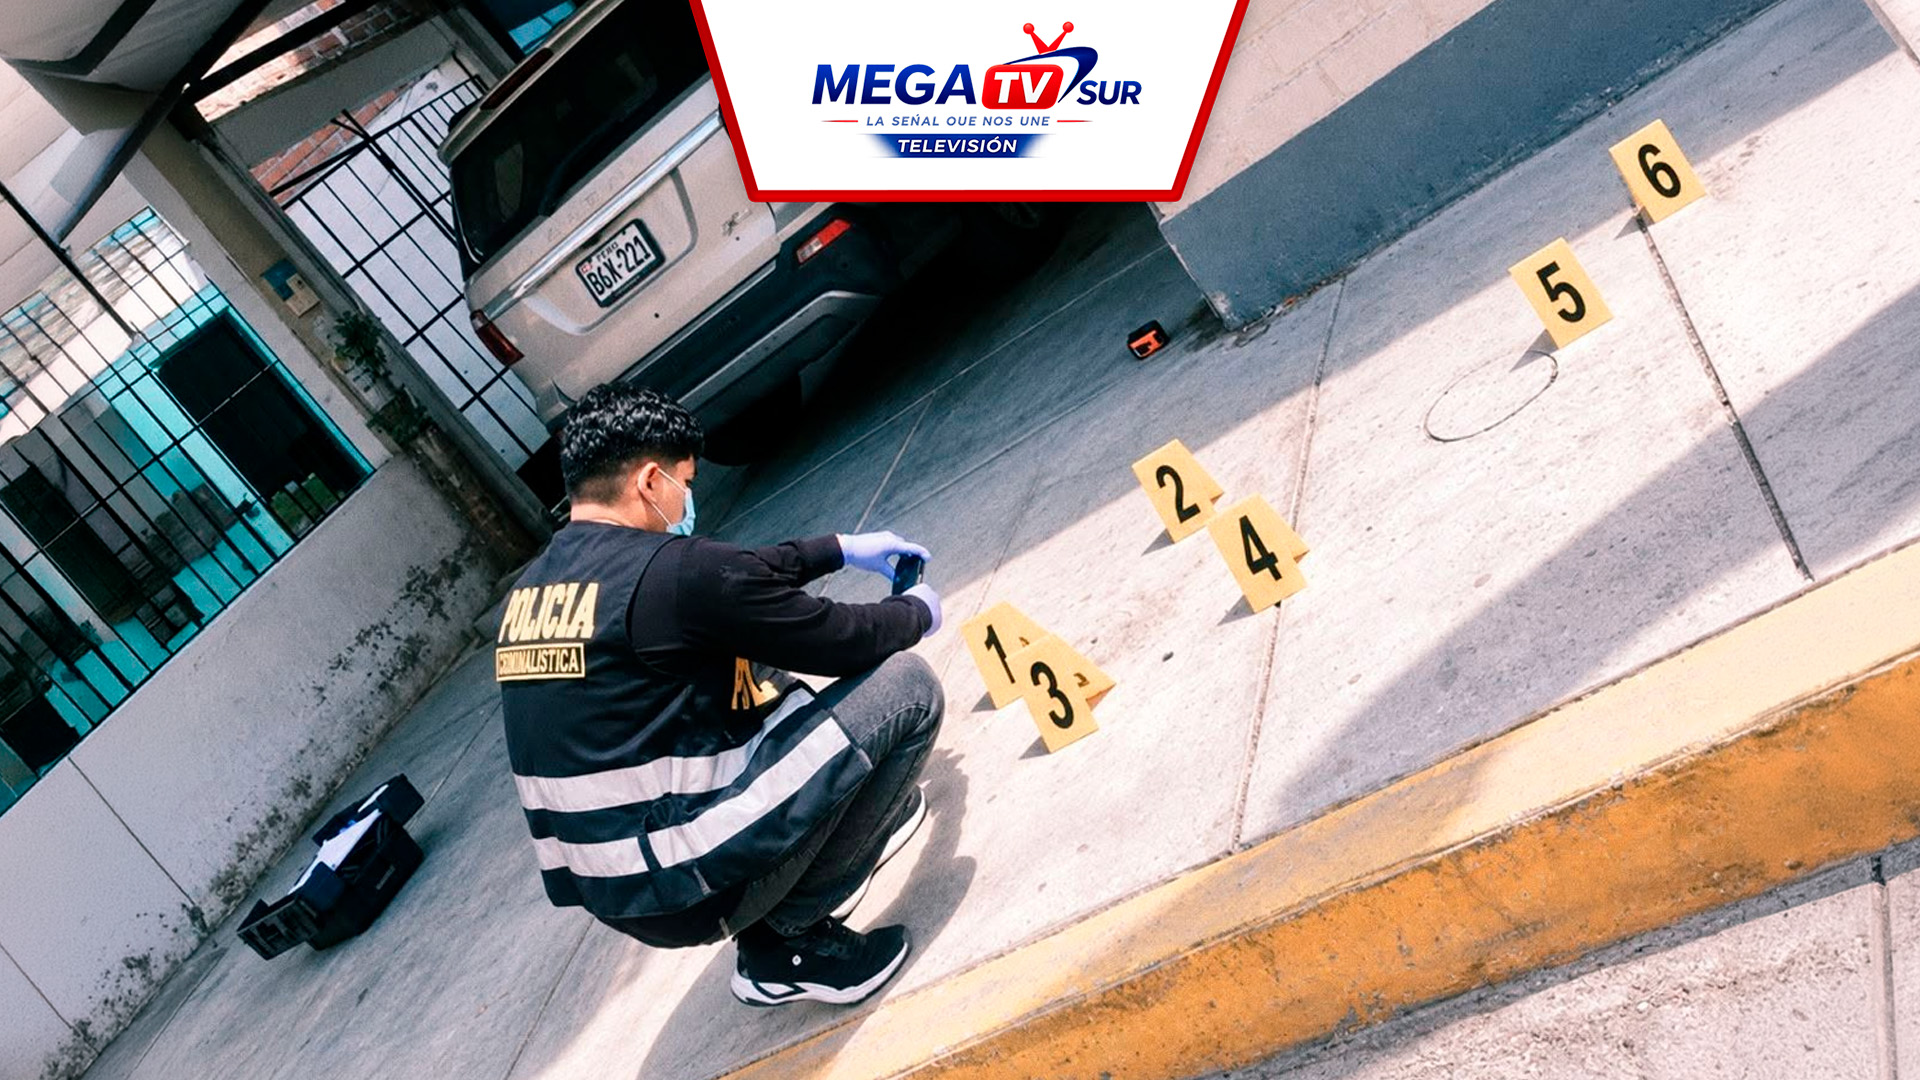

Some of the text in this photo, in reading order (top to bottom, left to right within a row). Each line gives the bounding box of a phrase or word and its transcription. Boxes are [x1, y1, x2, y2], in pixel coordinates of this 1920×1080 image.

[1638, 143, 1681, 198] 6
[586, 235, 651, 295] B6X-221
[1536, 260, 1586, 323] 5
[1156, 464, 1201, 523] 2
[1239, 515, 1283, 581] 4
[498, 582, 599, 643] POLICIA
[984, 624, 1016, 684] 1
[1030, 661, 1075, 729] 3
